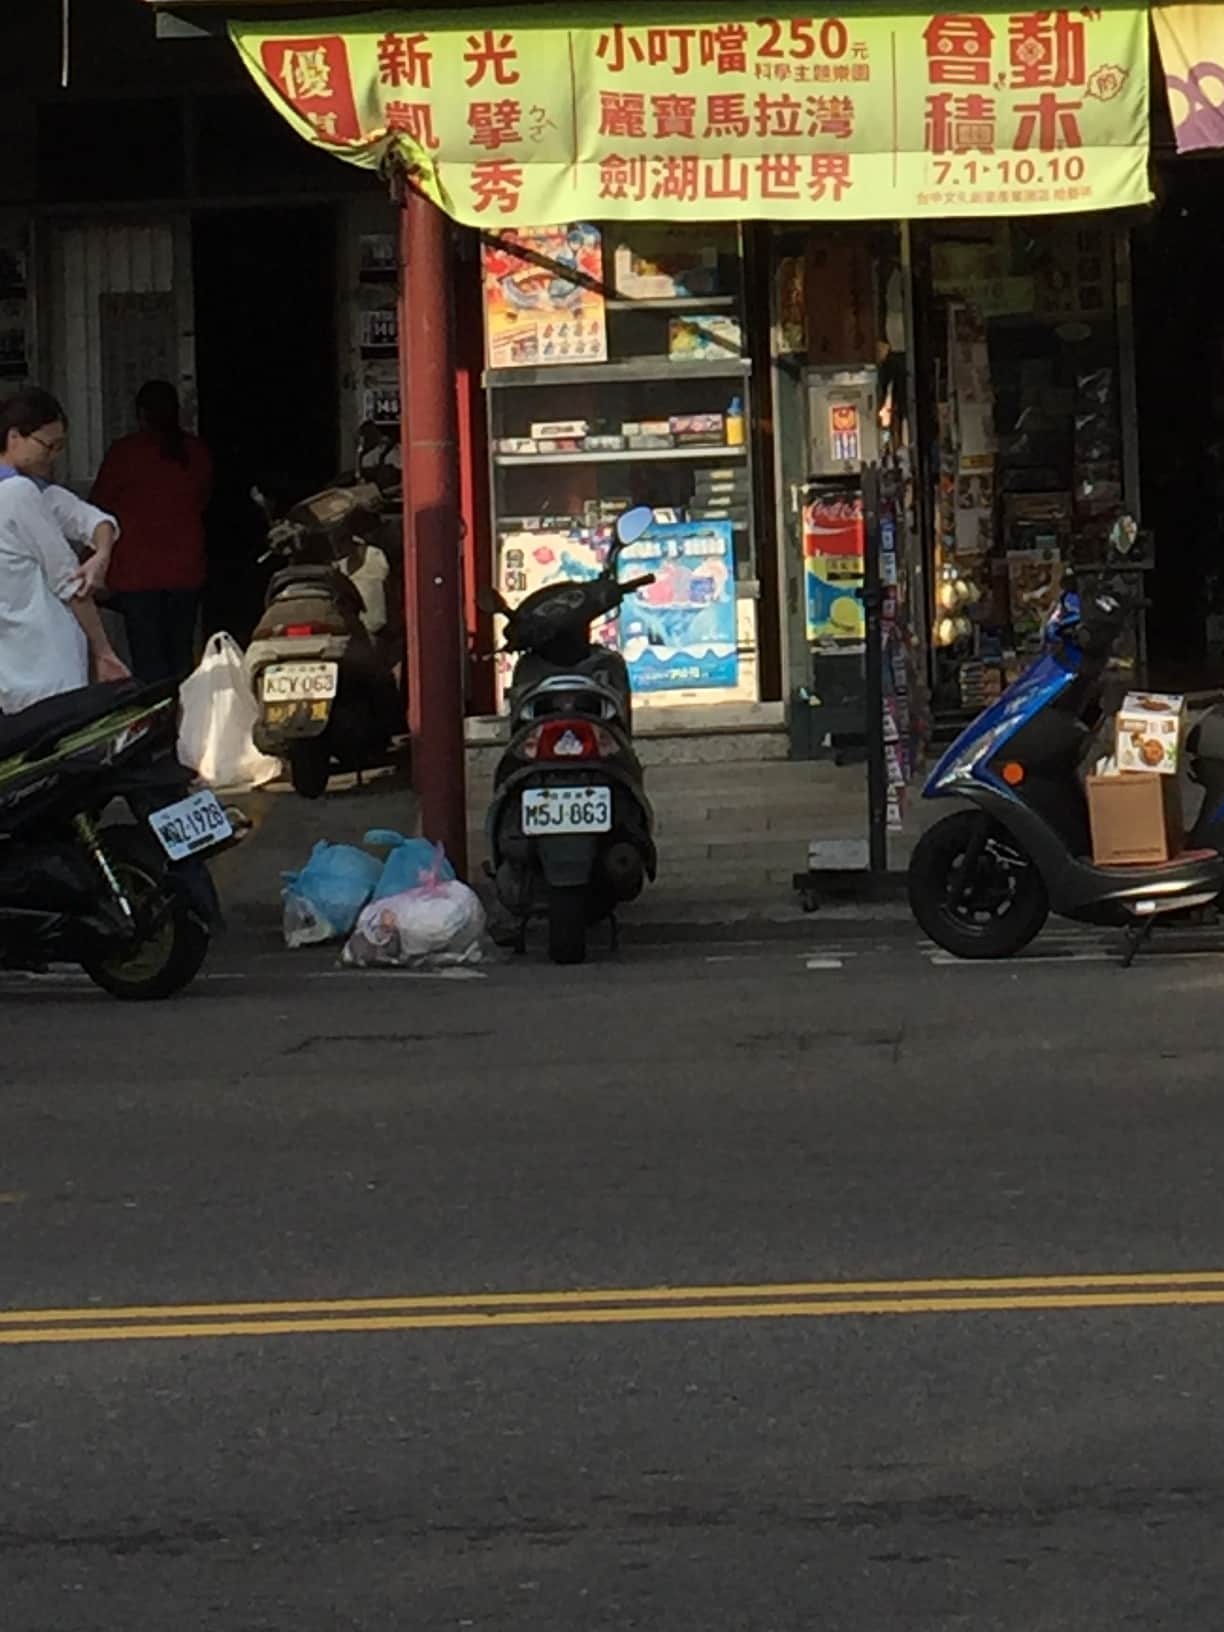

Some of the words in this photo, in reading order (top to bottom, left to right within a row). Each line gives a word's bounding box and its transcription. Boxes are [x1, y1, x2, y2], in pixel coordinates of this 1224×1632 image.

[598, 91, 854, 141] 麗寶馬拉灣
[924, 92, 1084, 156] 積木
[599, 152, 854, 203] 劍湖山世界
